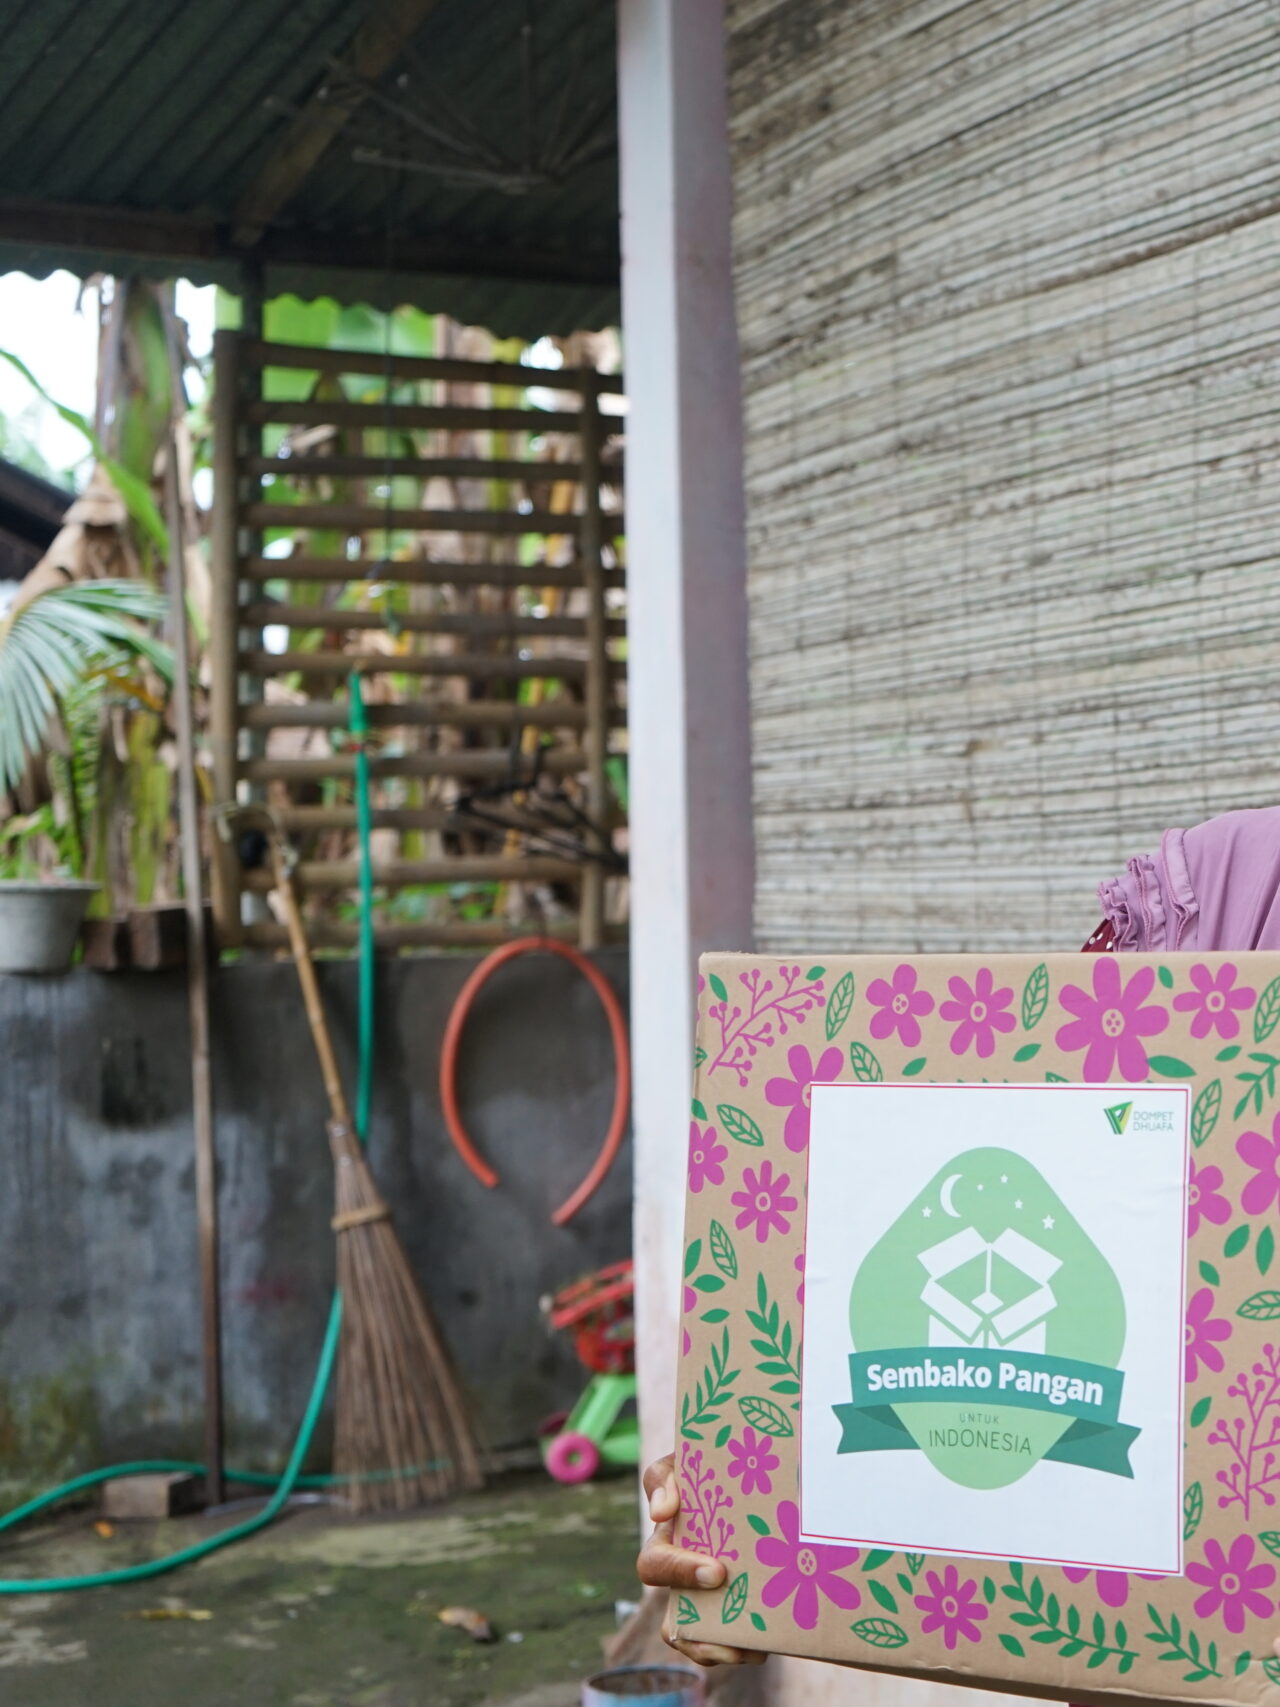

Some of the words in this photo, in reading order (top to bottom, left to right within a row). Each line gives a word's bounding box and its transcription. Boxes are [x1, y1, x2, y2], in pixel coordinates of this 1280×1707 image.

[1133, 1111, 1174, 1121] DOMPET
[1133, 1121, 1174, 1131] DHUAFA
[867, 1359, 992, 1391] Sembako
[998, 1362, 1103, 1405] Pangan
[959, 1412, 1000, 1425] UNTUK
[929, 1428, 1032, 1455] INDONESIA
